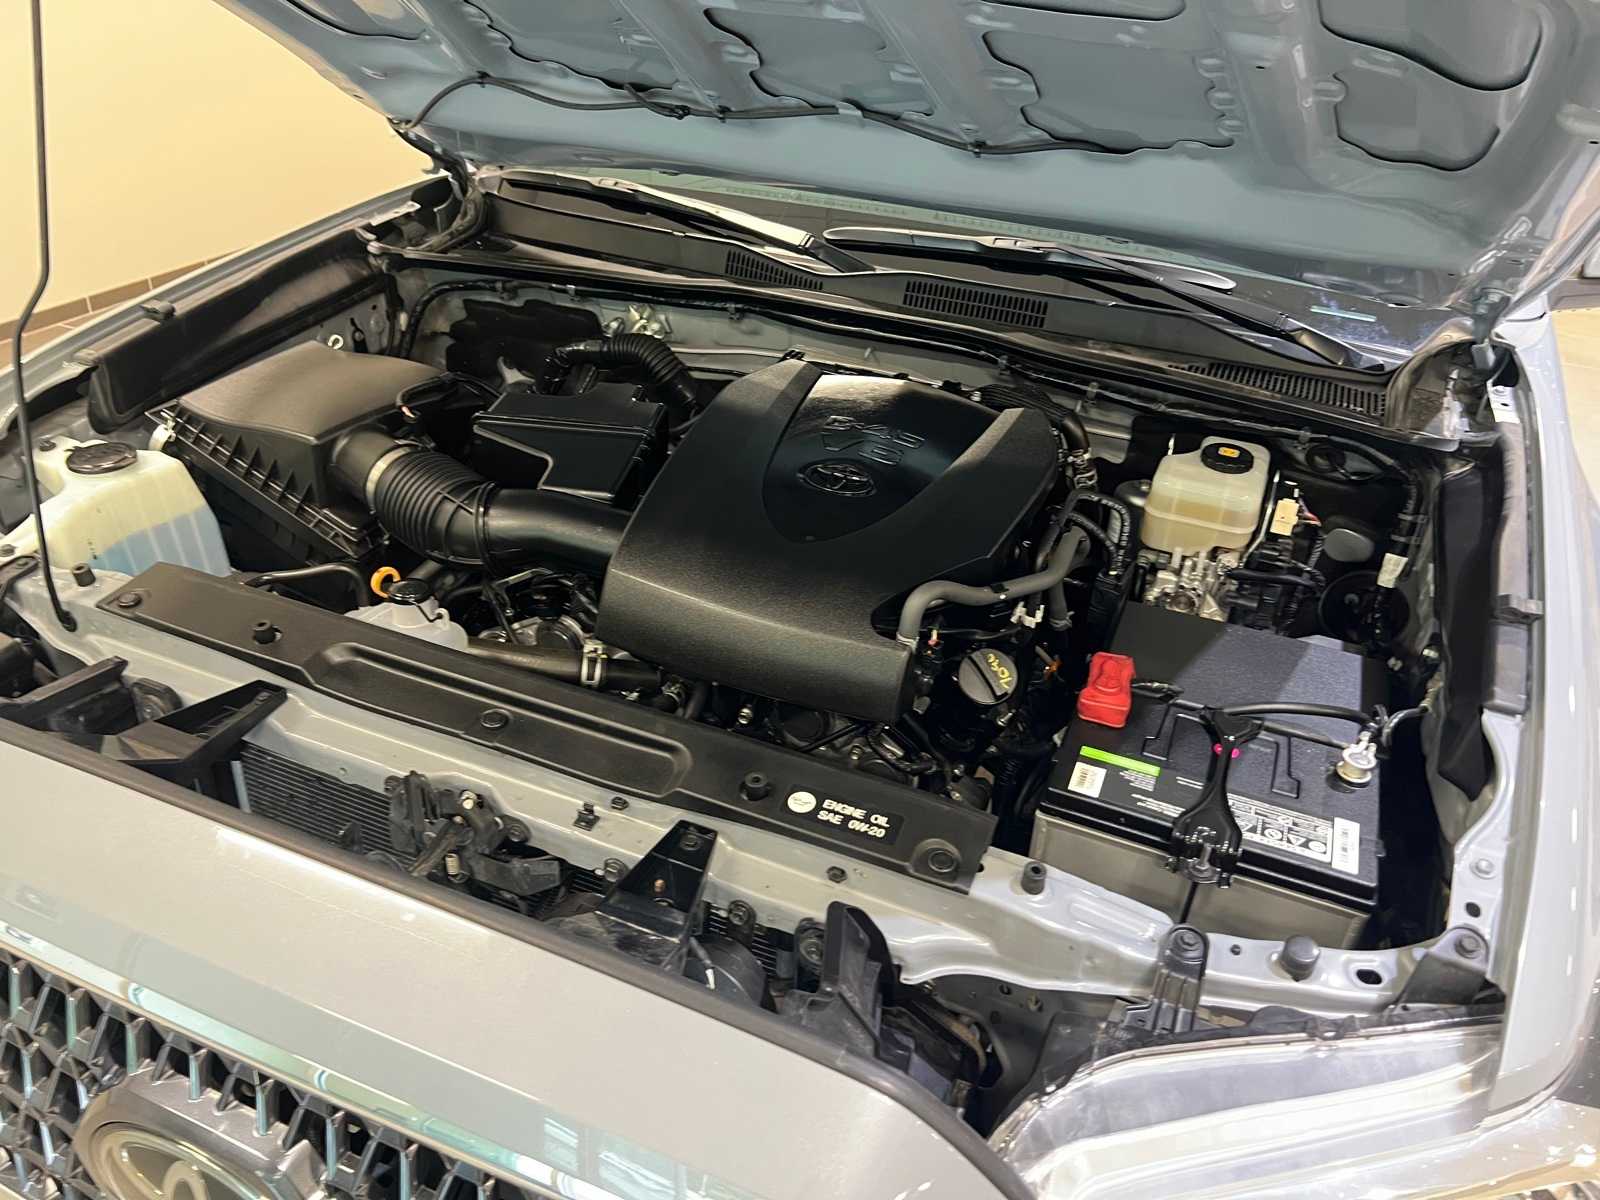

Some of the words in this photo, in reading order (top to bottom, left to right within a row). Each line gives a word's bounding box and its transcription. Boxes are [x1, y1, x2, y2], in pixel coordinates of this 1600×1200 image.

[817, 811, 843, 825] SAE
[847, 820, 886, 838] 0W-20
[822, 799, 867, 819] ENGINE
[869, 814, 890, 828] OIL
